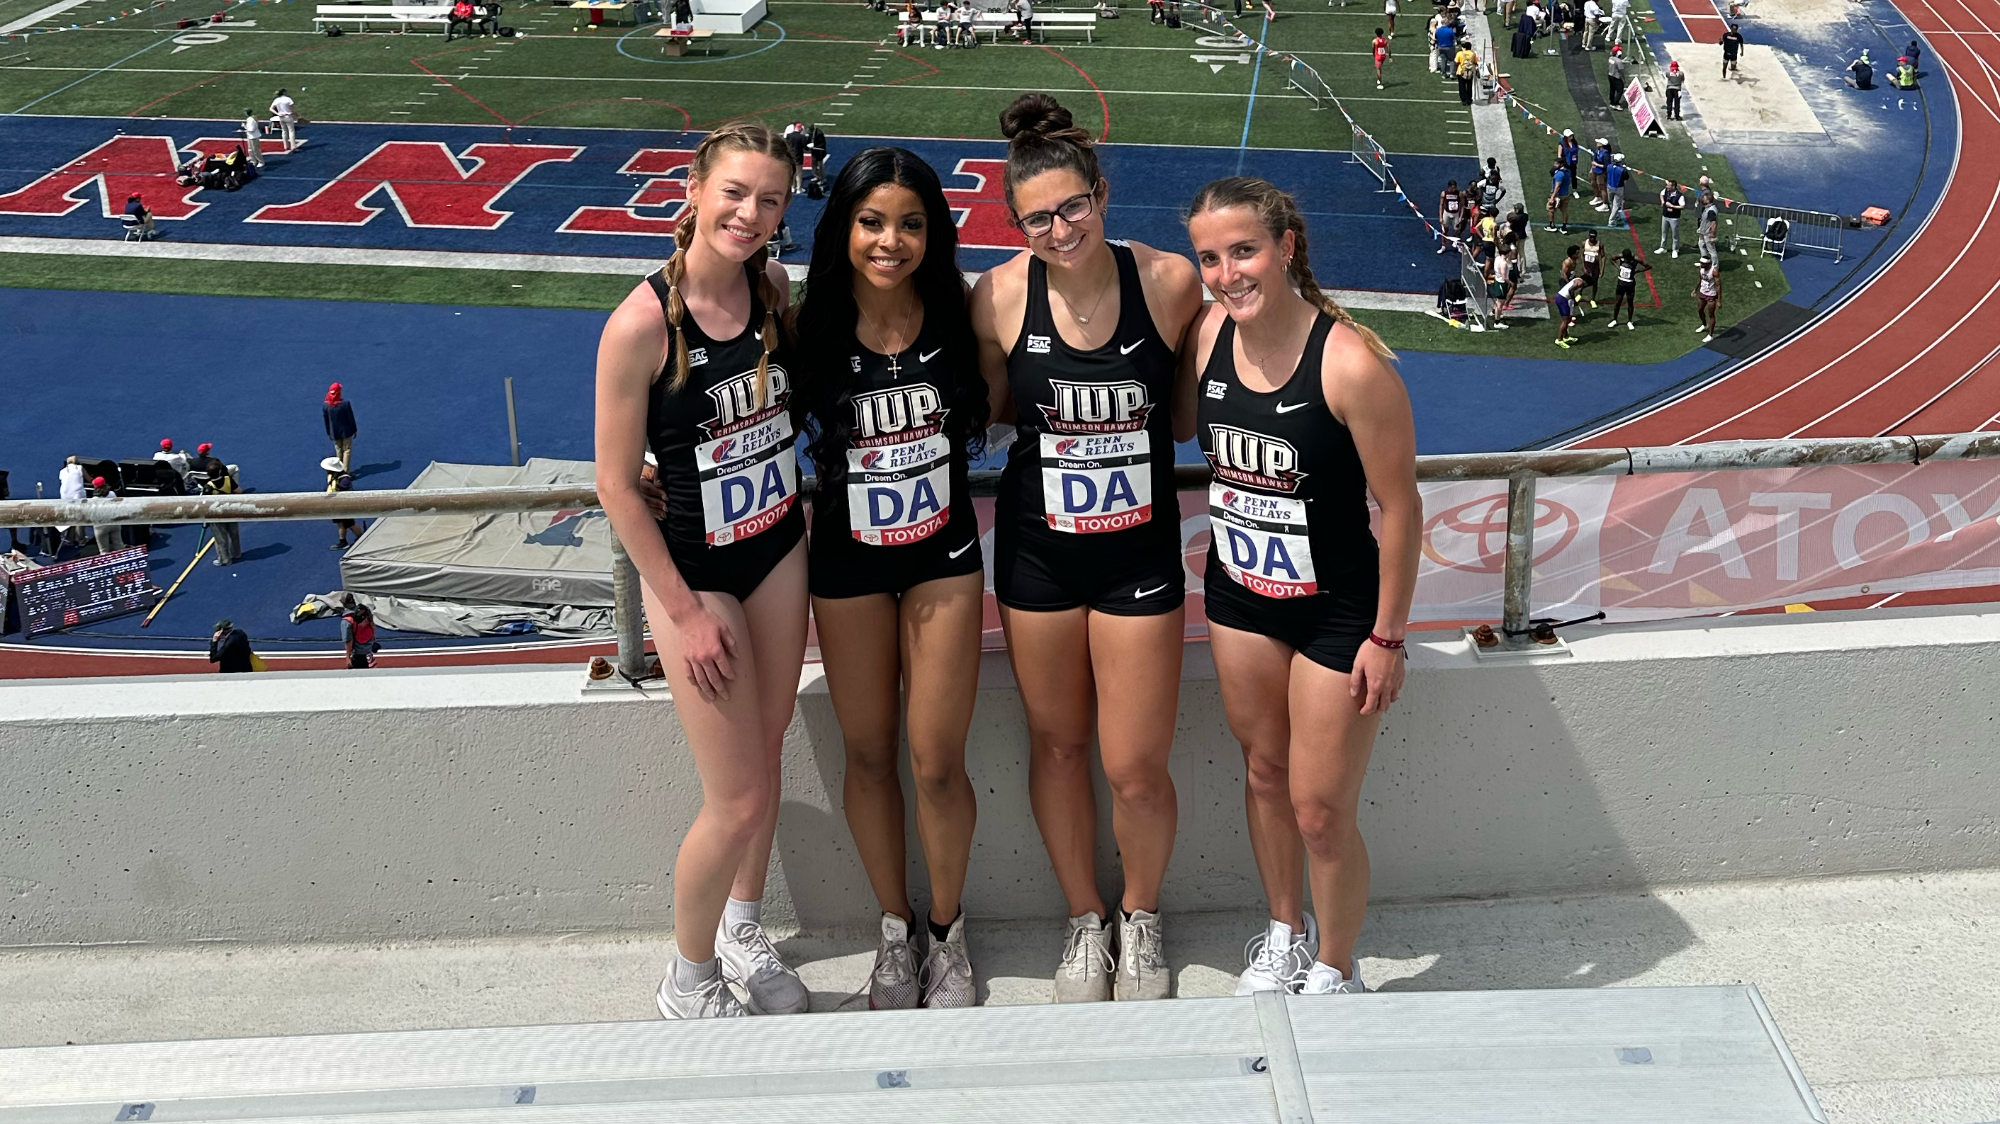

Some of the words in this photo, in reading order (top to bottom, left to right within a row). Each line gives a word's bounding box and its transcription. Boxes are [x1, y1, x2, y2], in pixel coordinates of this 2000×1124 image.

[713, 367, 788, 427] IUP
[1057, 384, 1146, 421] IUP
[856, 387, 940, 438] IUP
[717, 417, 755, 437] CRIMSON
[742, 423, 773, 444] PENN
[1056, 421, 1101, 431] CRIMSON
[1104, 421, 1138, 431] HAWKS
[742, 428, 781, 455] RELAYS
[859, 434, 900, 448] CRIMSON
[903, 428, 935, 441] HAWKS
[1085, 435, 1123, 446] PENN
[890, 442, 926, 458] PENN
[890, 448, 937, 468] RELAYS
[1084, 441, 1135, 456] RELAYS
[1214, 428, 1294, 479] IUP
[717, 461, 744, 476] Dream
[744, 458, 758, 469] On.
[1058, 460, 1086, 469] Dream
[1086, 460, 1102, 468] On.
[864, 473, 892, 483] Dream
[892, 472, 908, 481] On.
[1218, 466, 1254, 484] CRIMSON
[1256, 475, 1289, 489] HAWKS
[720, 461, 787, 524] DA
[1061, 470, 1139, 513] DA
[867, 477, 941, 527] DA
[1244, 496, 1279, 509] PENN
[737, 503, 788, 537] TOYOTA
[1078, 511, 1141, 531] TOYOTA
[1223, 512, 1245, 526] Dream
[1245, 519, 1260, 529] On.
[1244, 505, 1291, 520] RELAYS
[884, 516, 943, 543] TOYOTA
[1226, 526, 1301, 580] DA
[1244, 575, 1307, 597] TOYOTA
